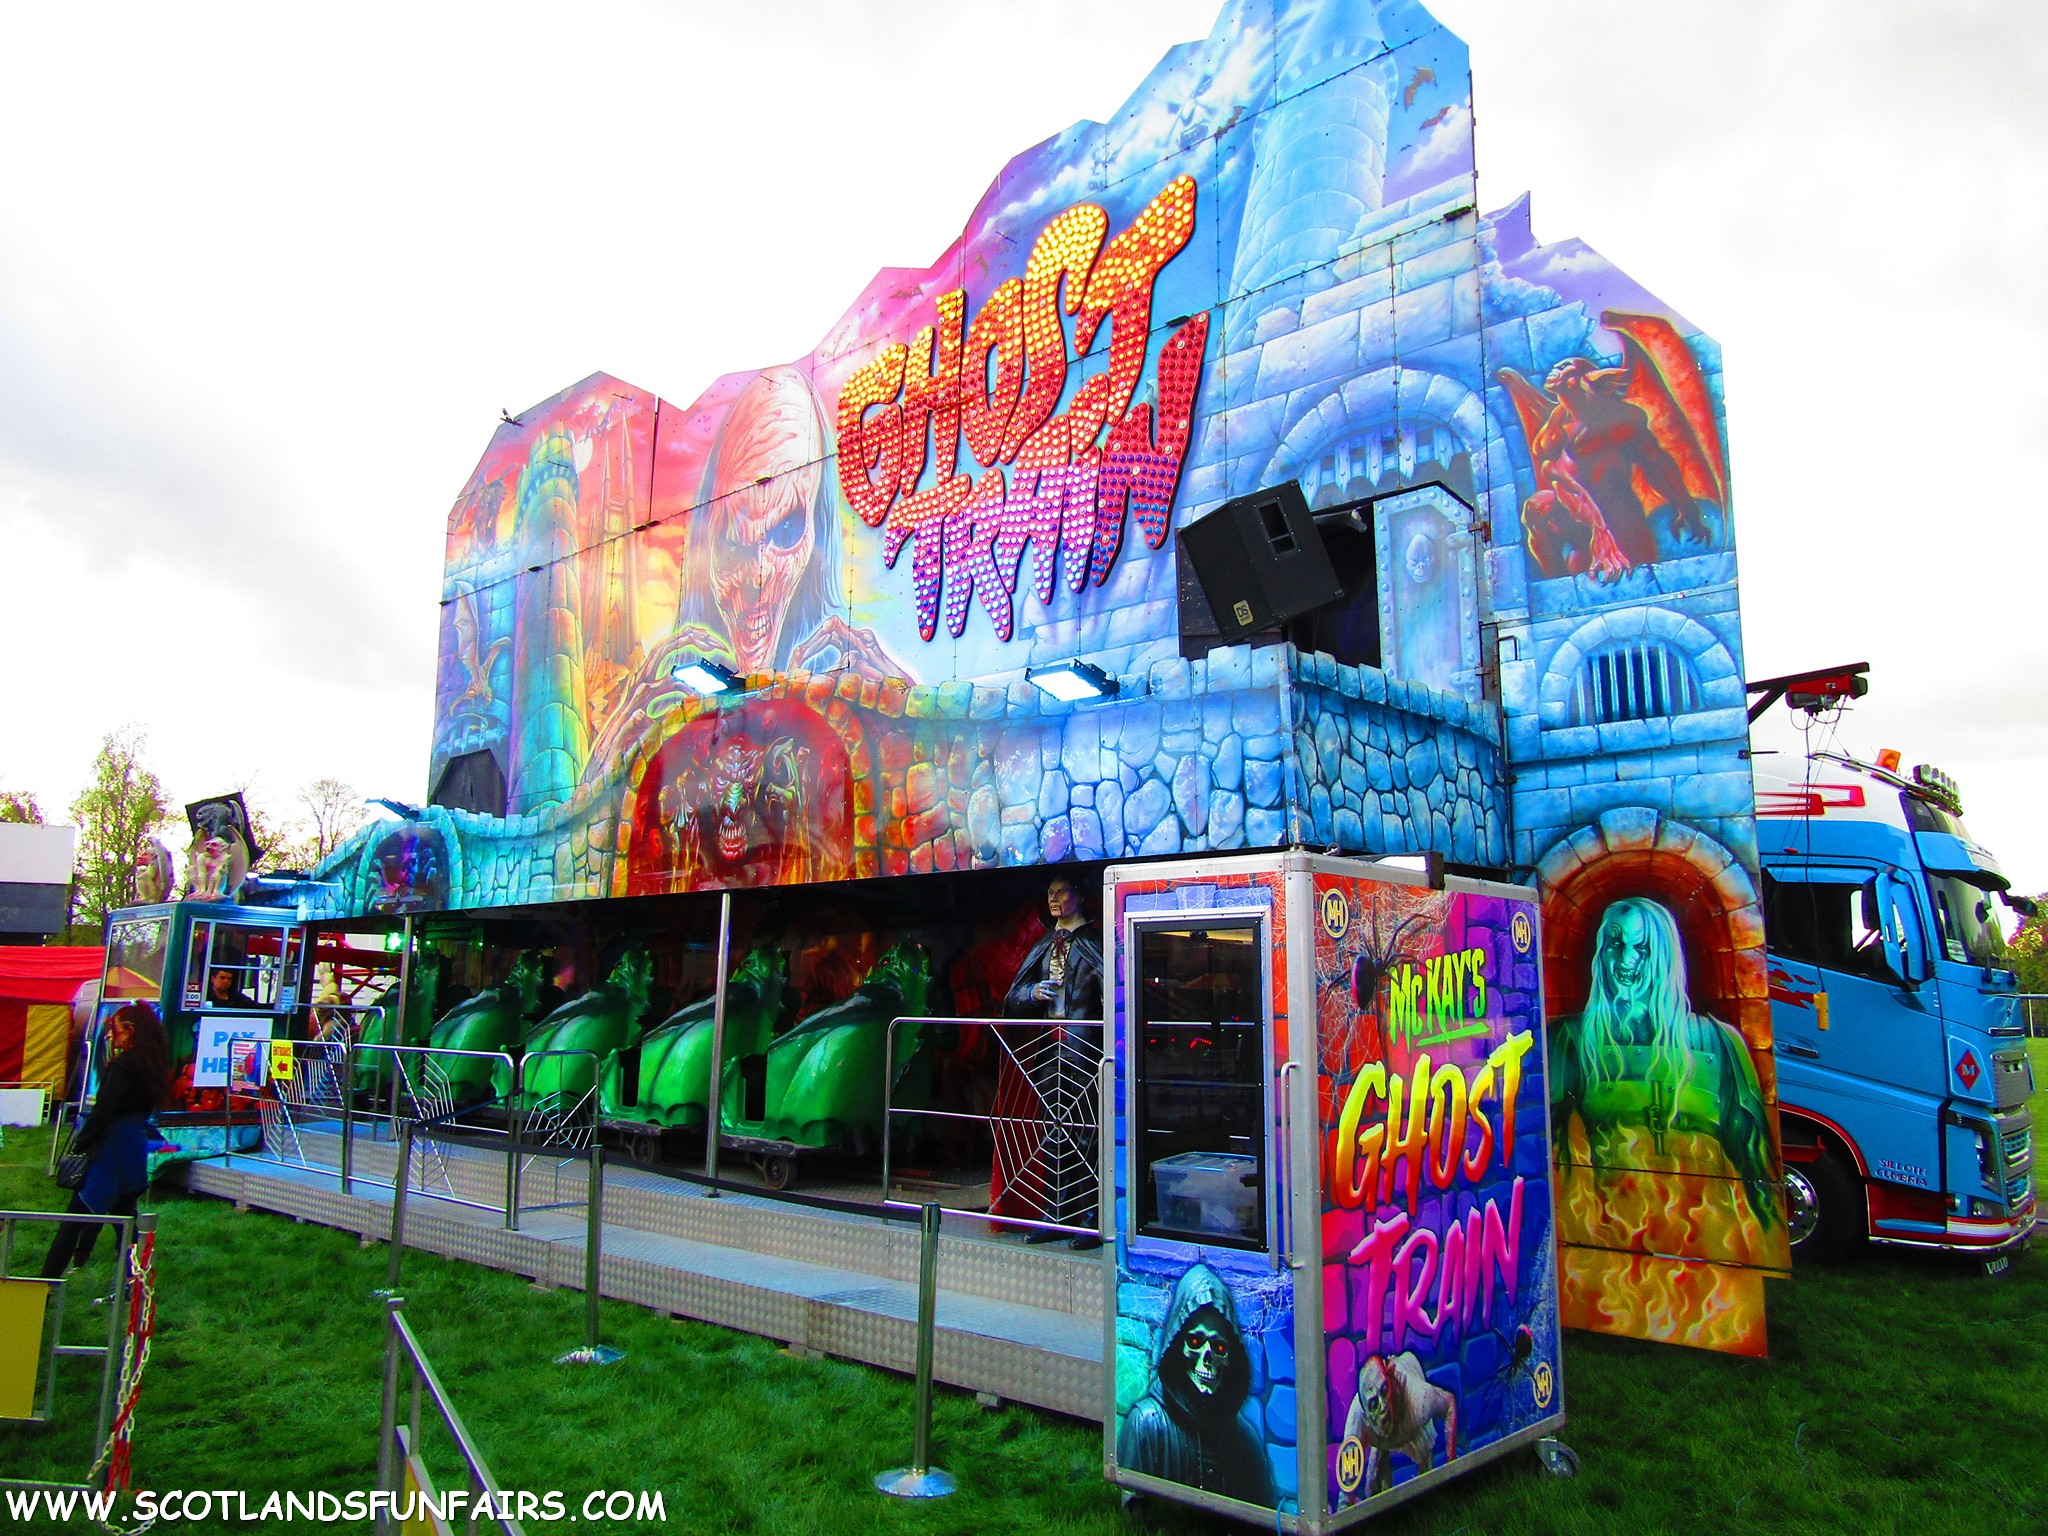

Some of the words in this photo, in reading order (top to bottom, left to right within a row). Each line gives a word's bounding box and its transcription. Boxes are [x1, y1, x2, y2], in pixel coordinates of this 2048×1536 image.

[837, 174, 1196, 527] GHOST
[883, 311, 1210, 642] TRAIN
[1962, 1063, 1976, 1076] M
[1333, 1029, 1534, 1218] GHOST
[1879, 1159, 1928, 1176] SILLOTH
[1875, 1168, 1928, 1187] CUMBRIA
[1348, 1176, 1525, 1355] TRAIN
[1985, 1256, 2009, 1275] VOLVO
